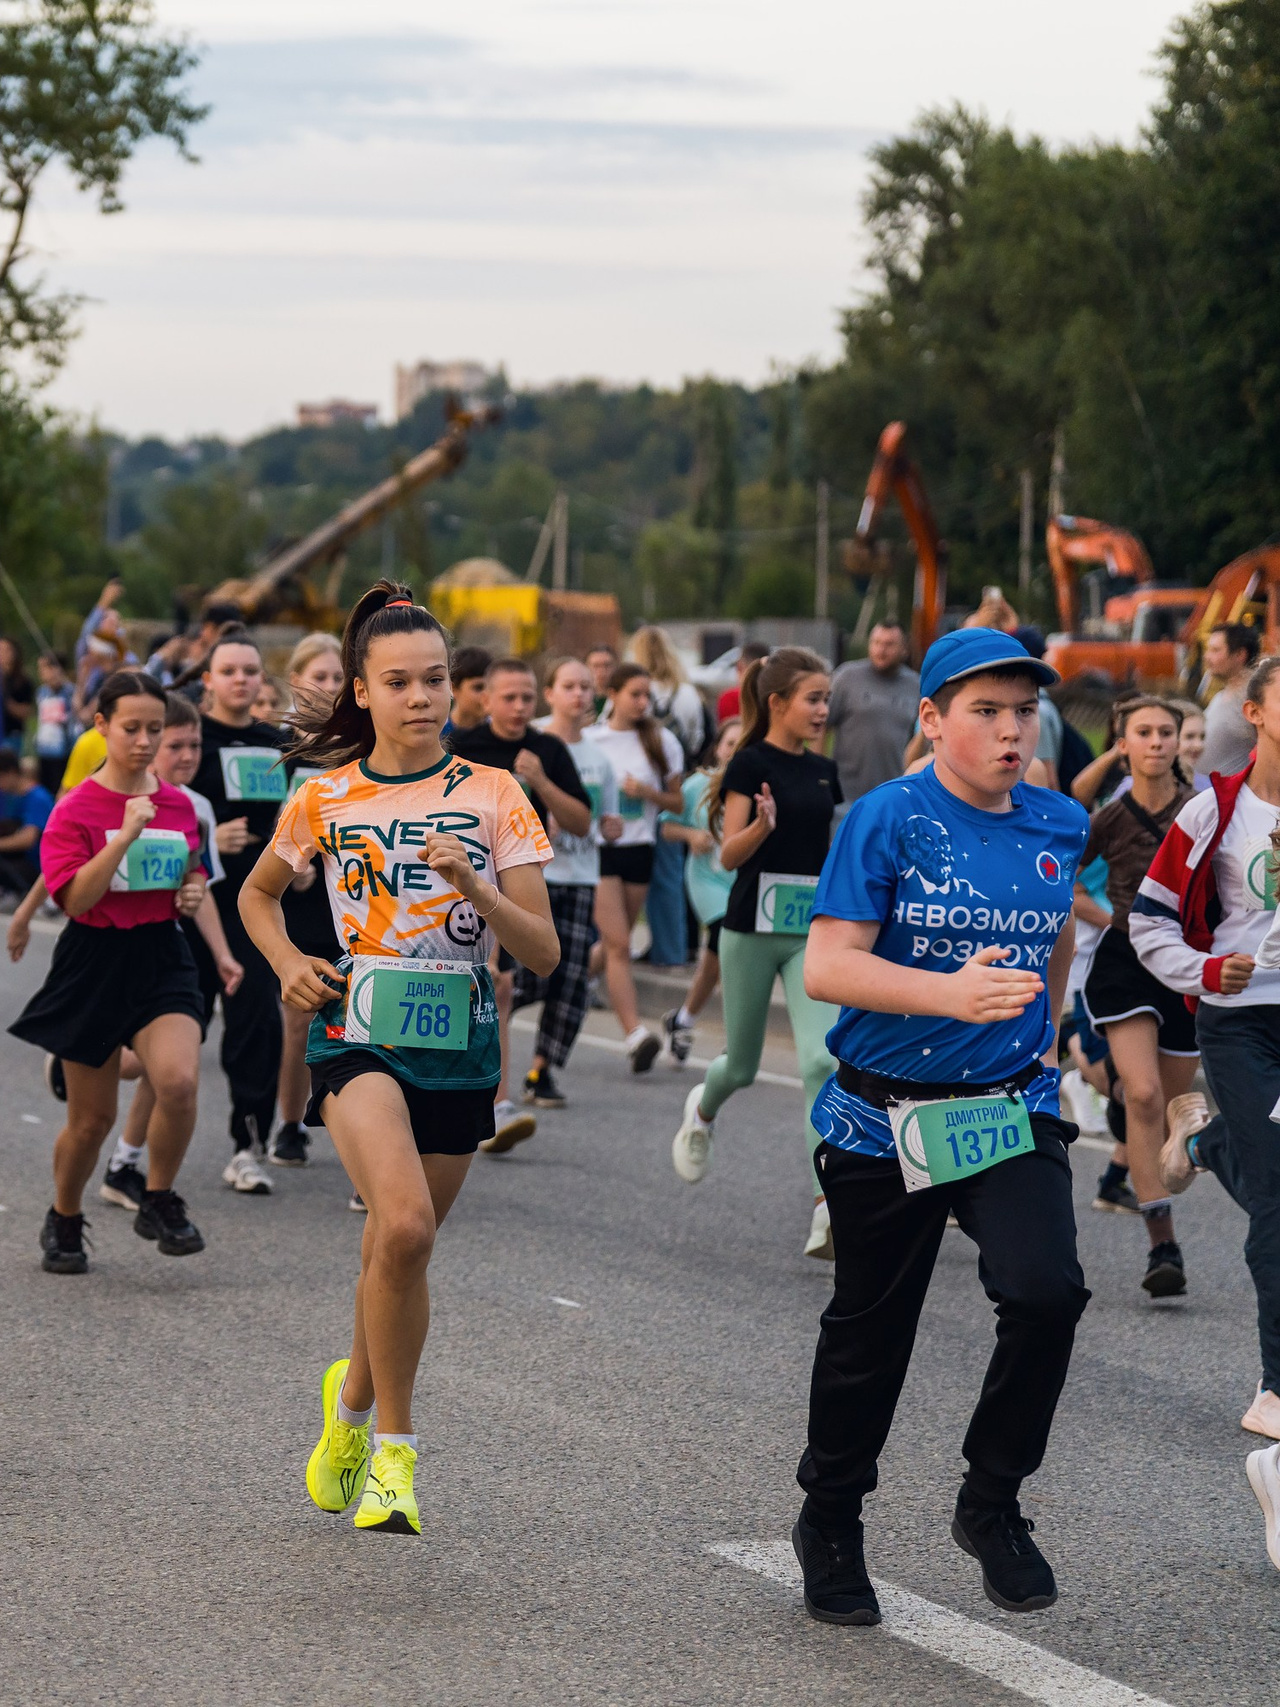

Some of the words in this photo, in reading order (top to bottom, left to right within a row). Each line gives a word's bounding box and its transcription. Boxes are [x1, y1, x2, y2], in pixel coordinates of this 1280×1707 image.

[318, 811, 491, 866] NEVER
[141, 857, 184, 882] 1240
[405, 982, 445, 998] ДАРЬЯ
[398, 1001, 451, 1038] 768
[945, 1103, 1008, 1128] ДМИТРИЙ
[946, 1124, 1020, 1168] 1370
